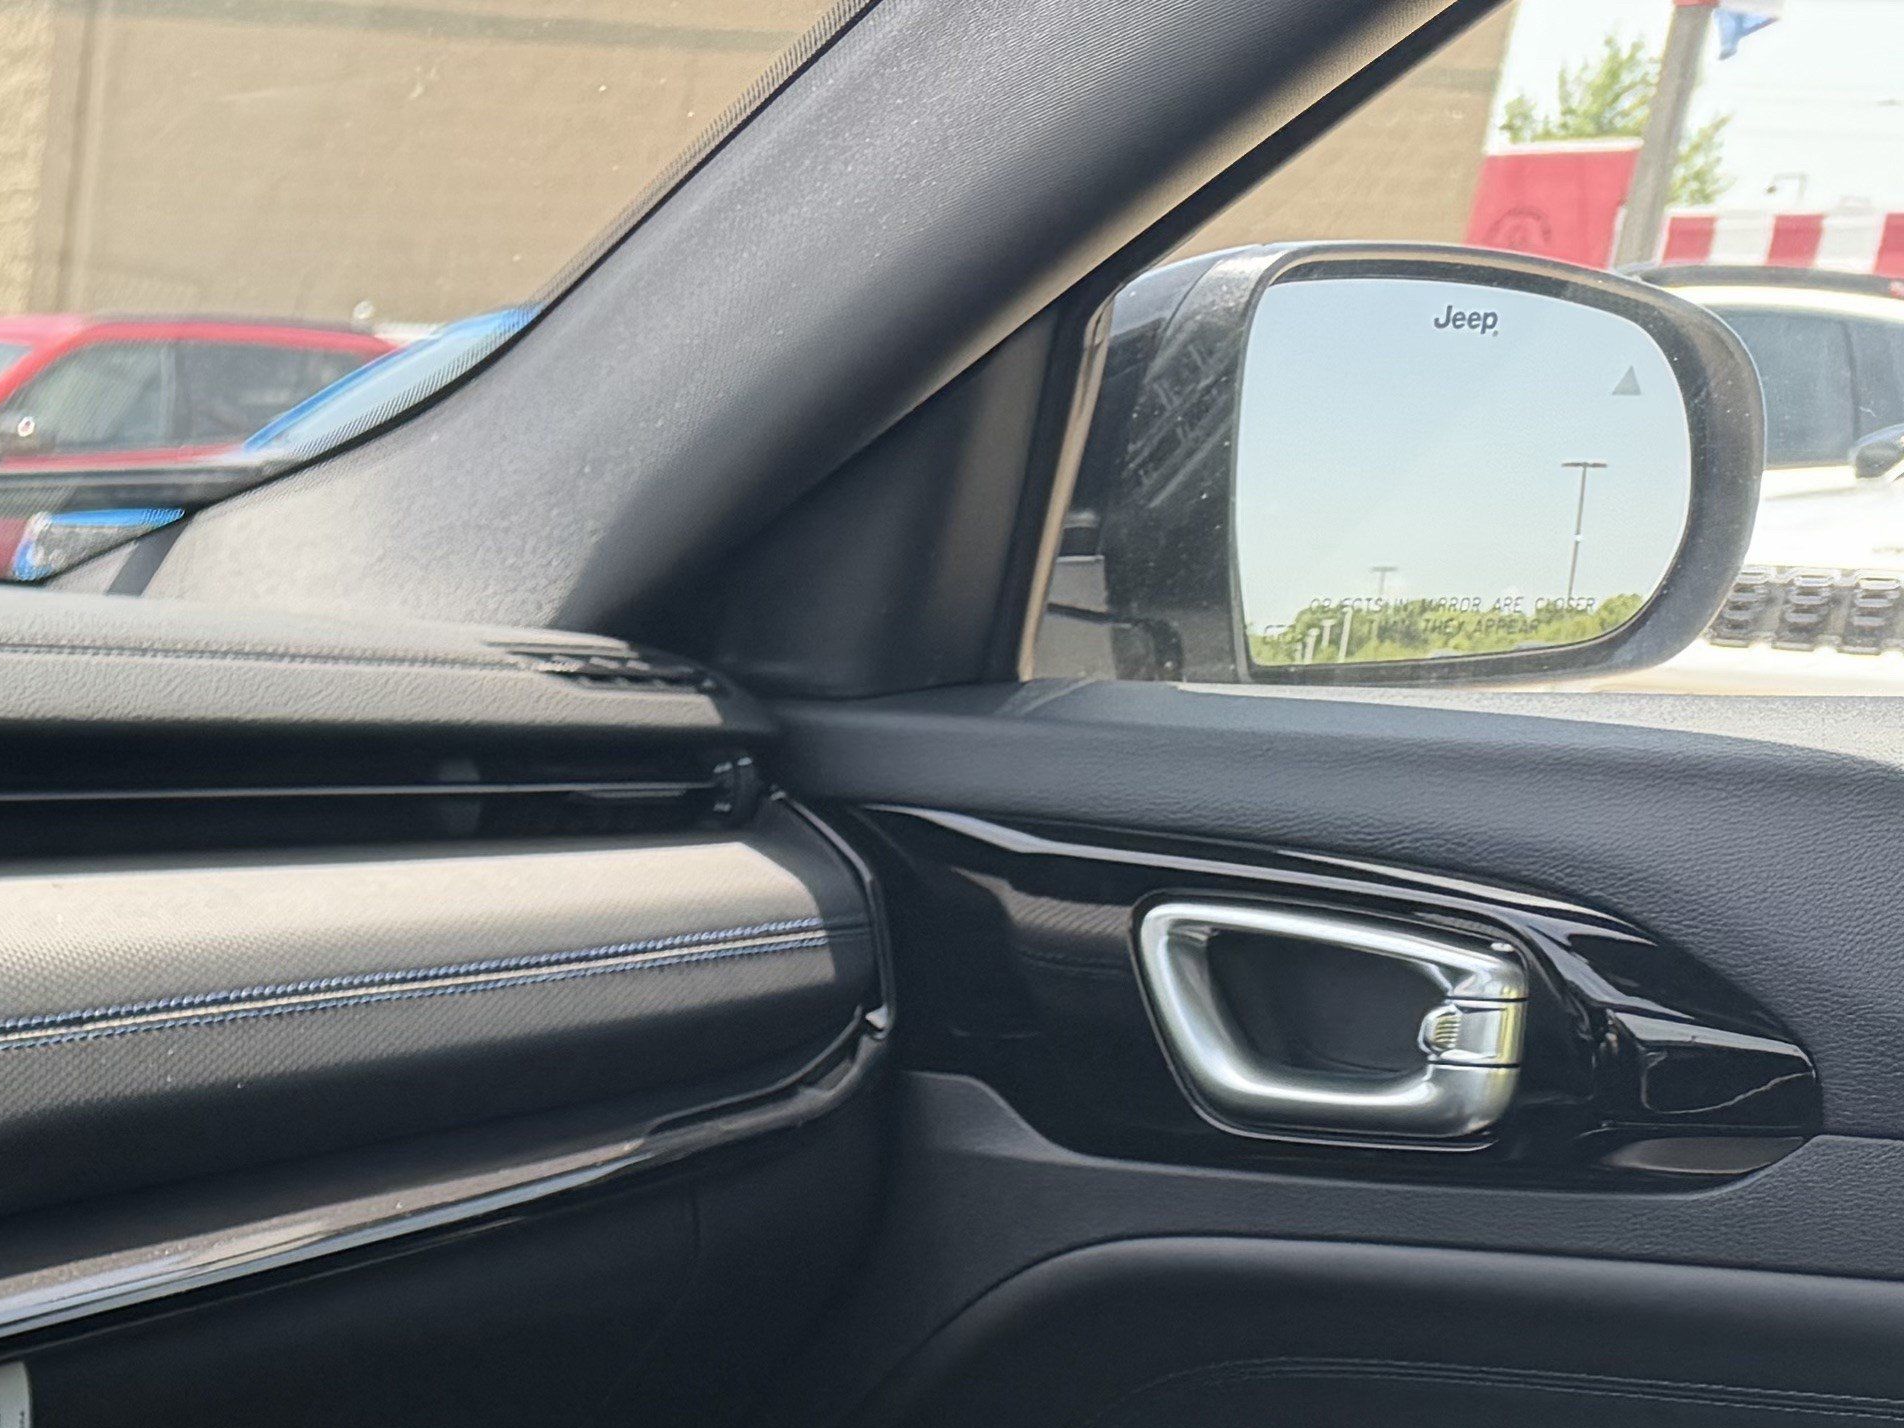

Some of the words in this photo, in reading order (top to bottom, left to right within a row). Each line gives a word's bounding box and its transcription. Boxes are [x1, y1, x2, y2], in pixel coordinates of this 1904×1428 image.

[1433, 304, 1499, 336] Jeep
[1309, 597, 1383, 612] OBJECTS
[1421, 597, 1481, 612] MIRROR
[1493, 596, 1525, 612] ARE
[1534, 596, 1596, 612] CLOSER
[1422, 618, 1465, 635] THEY
[1472, 618, 1540, 634] APPEAR
